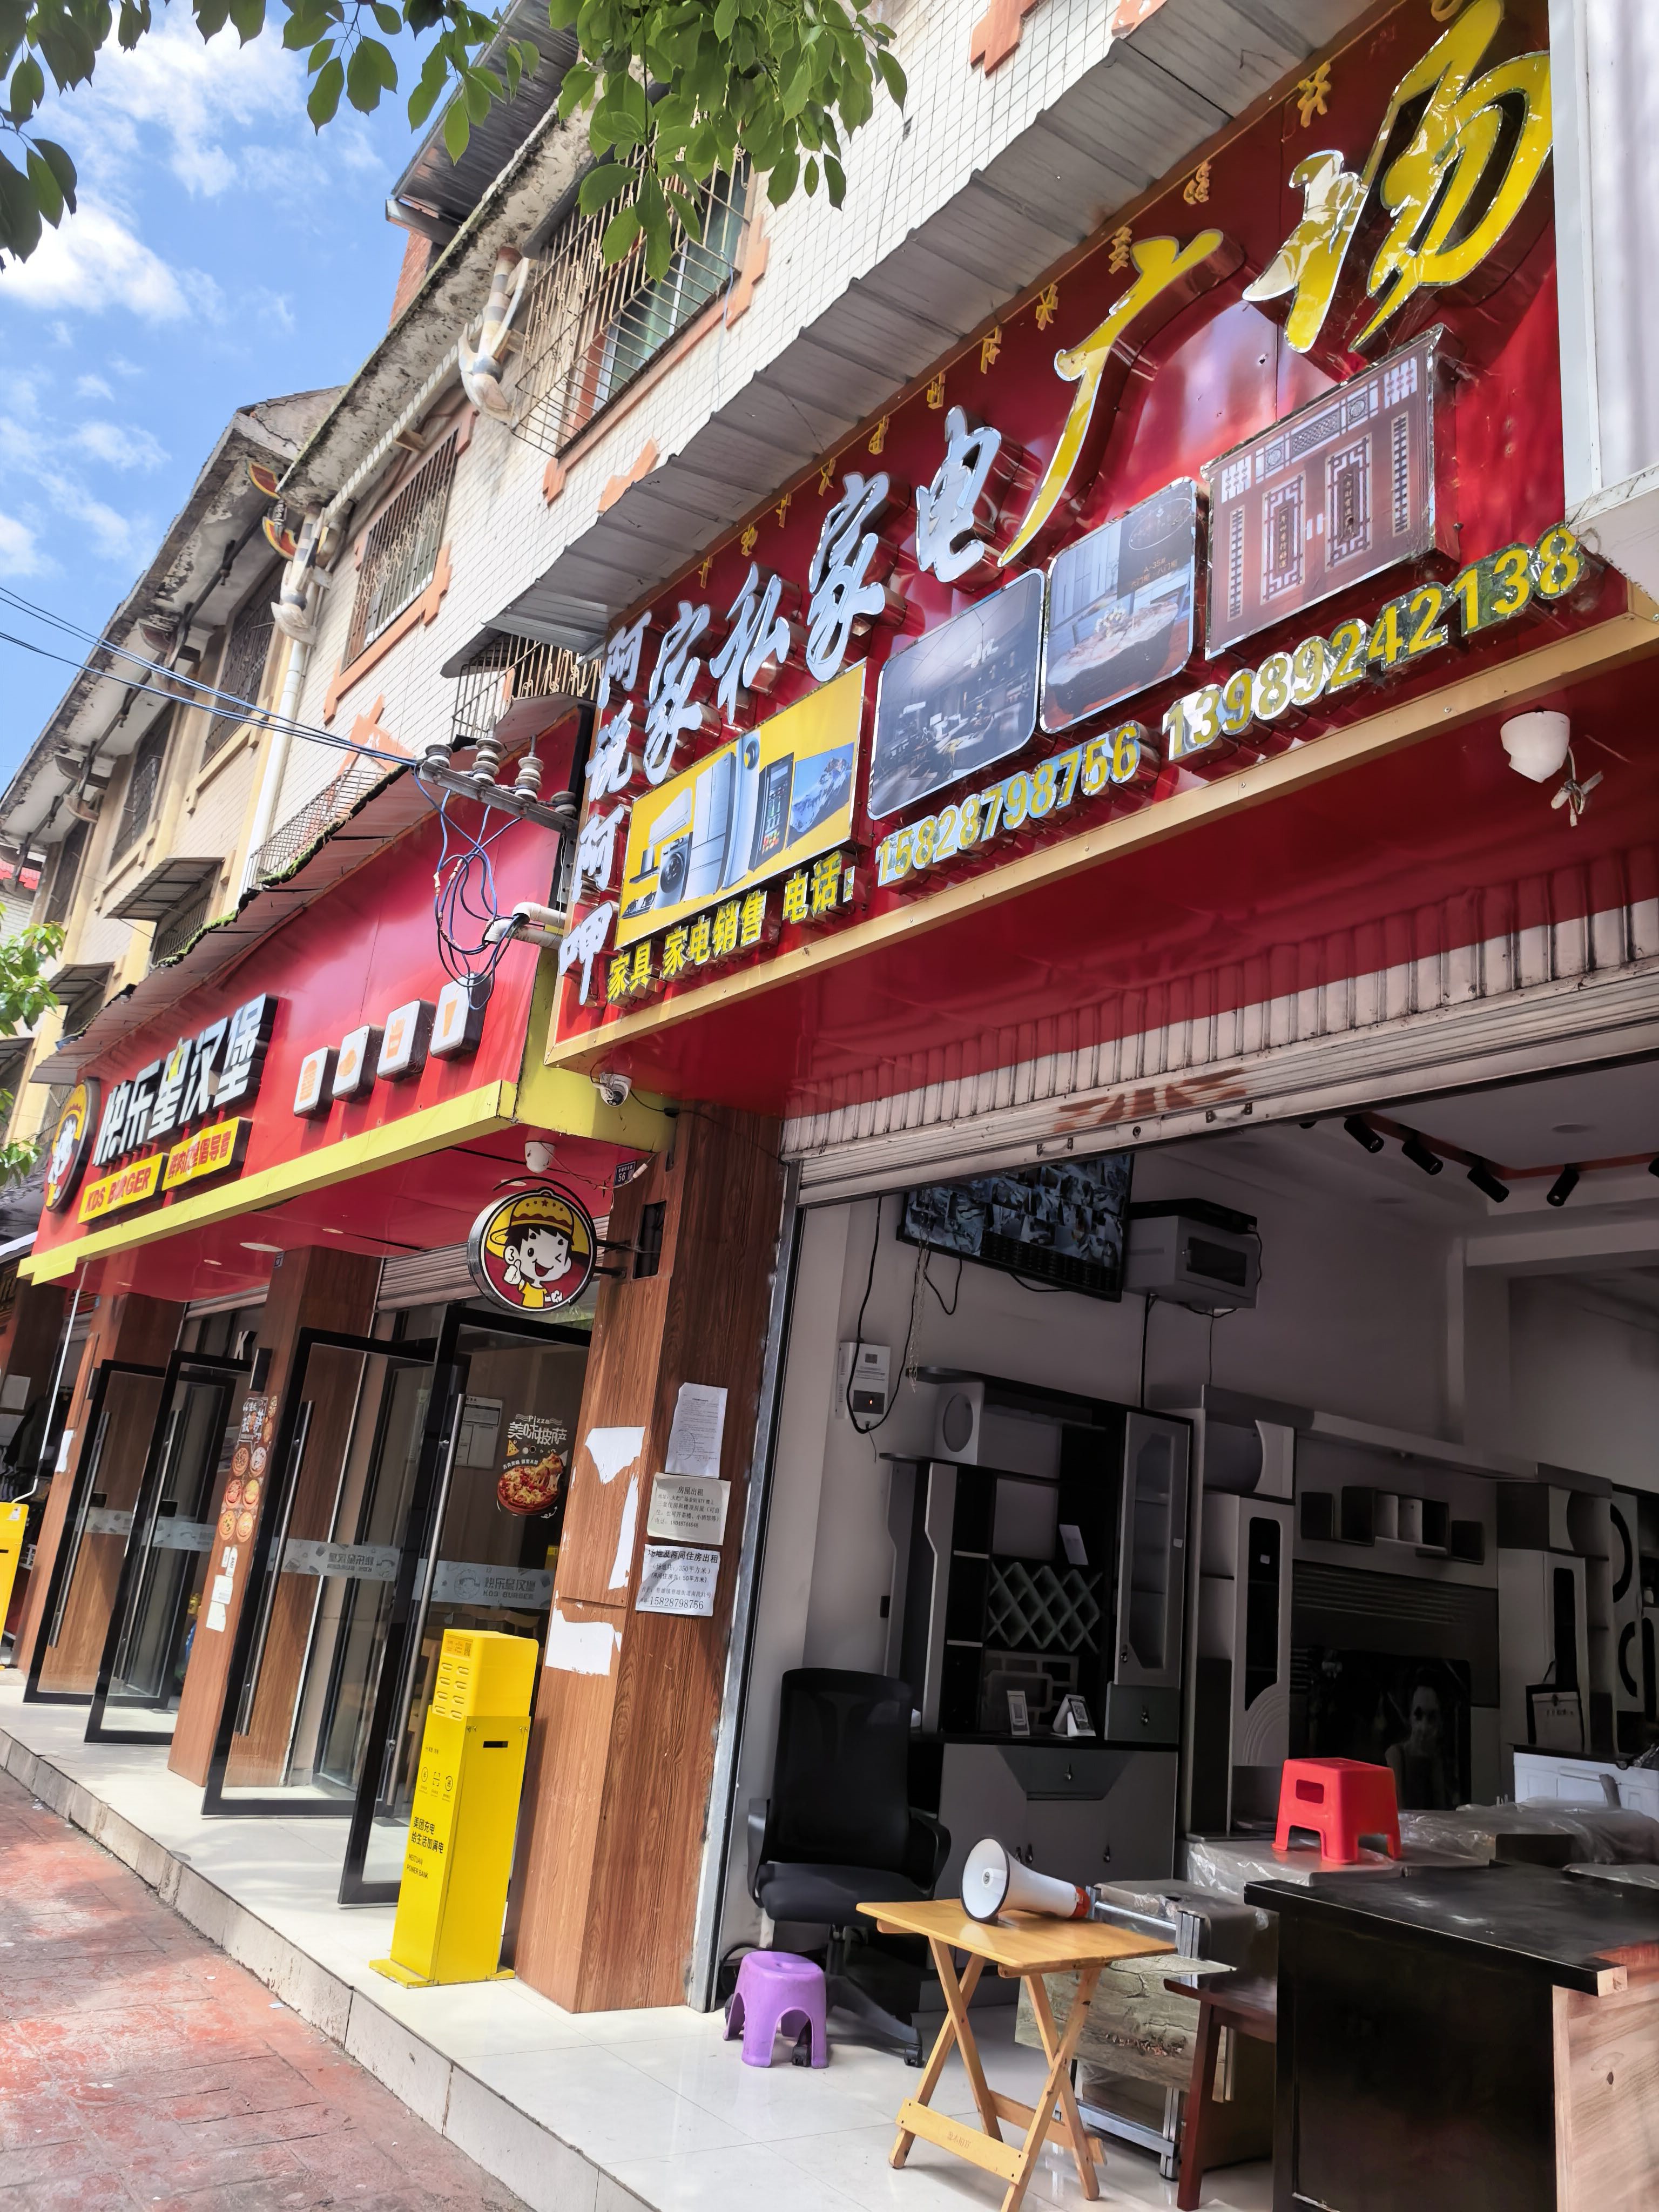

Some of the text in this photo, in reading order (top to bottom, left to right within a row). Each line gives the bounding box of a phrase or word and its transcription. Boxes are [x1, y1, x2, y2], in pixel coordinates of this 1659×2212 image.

[606, 939, 652, 1003] 家具
[662, 889, 767, 976] 家电销售
[876, 720, 1139, 887] 15828798756
[1162, 522, 1586, 761] 13989242138
[92, 993, 267, 1166] 快乐星汉堡
[618, 1172, 626, 1182] 56
[85, 1166, 151, 1213] KDS BURGER
[528, 1415, 550, 1424] Pizza
[508, 1421, 568, 1445] 美味披萨
[677, 1486, 704, 1496] 房屋出租
[648, 1549, 718, 1563] 场地及两间住房出租
[650, 1596, 704, 1610] 15828798756
[413, 1816, 435, 1835] 美团充电
[411, 1832, 444, 1854] 给生活加满电
[408, 1853, 423, 1865] MEITUAN
[406, 1864, 429, 1879] POWER BANK
